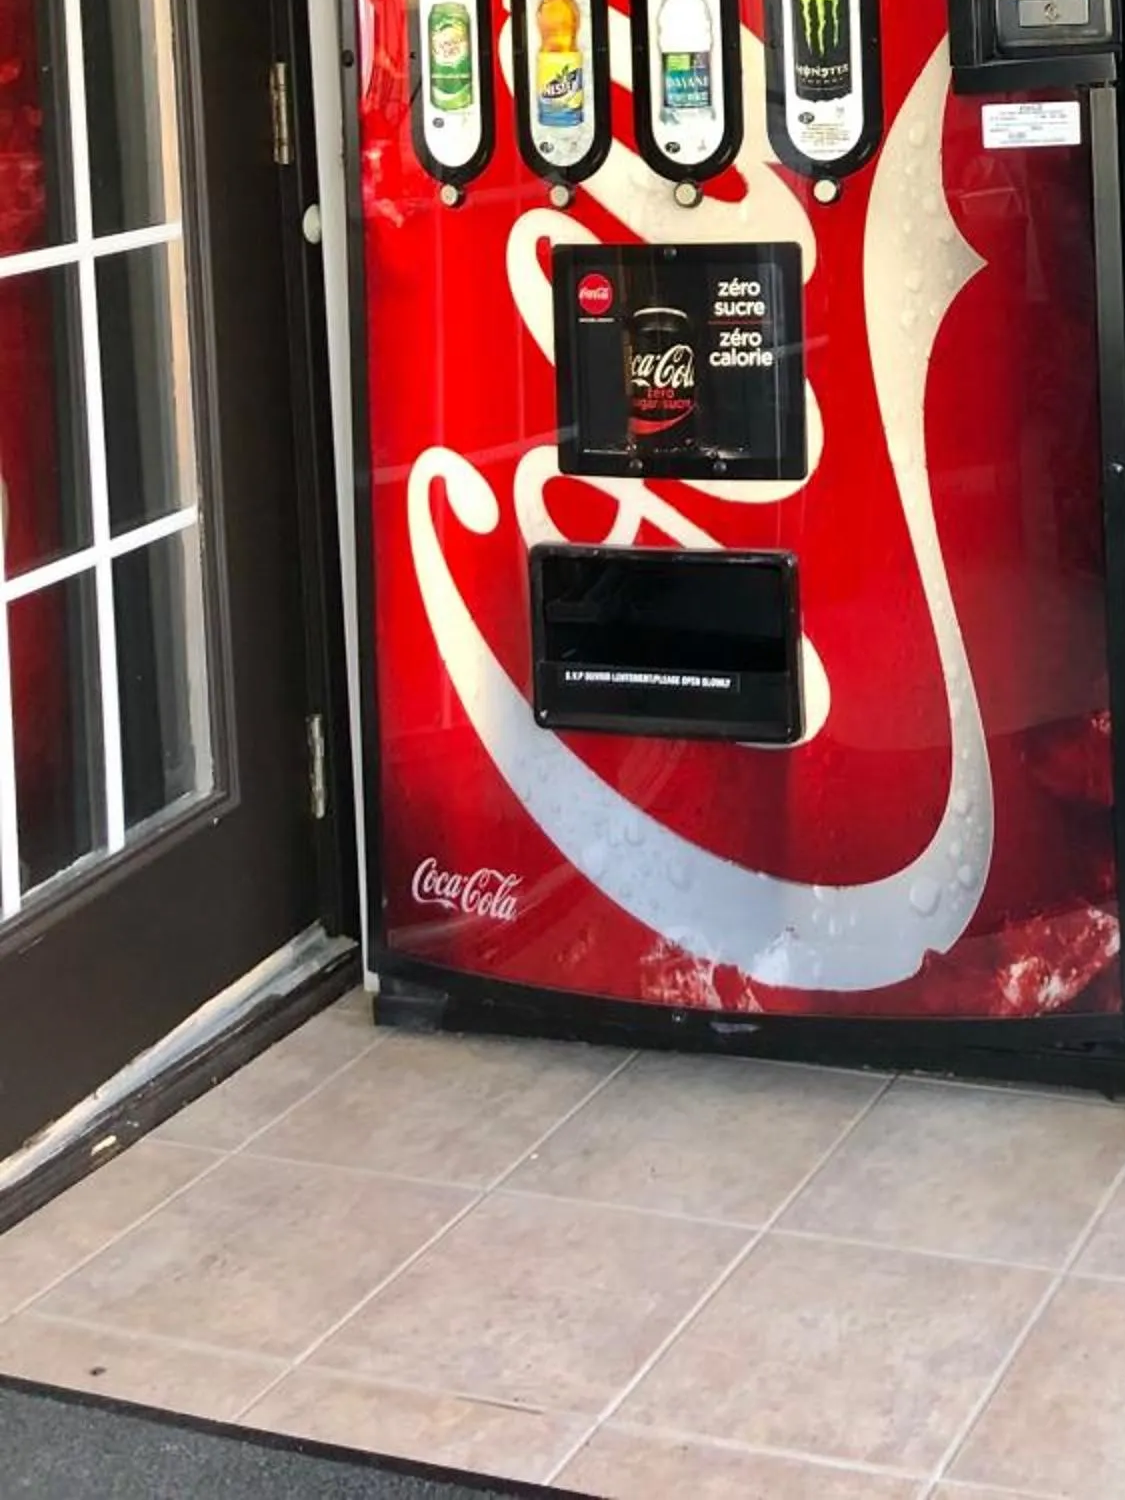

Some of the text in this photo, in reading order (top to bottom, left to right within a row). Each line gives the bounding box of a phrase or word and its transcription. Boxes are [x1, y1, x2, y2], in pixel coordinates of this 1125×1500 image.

[718, 277, 761, 297] zéro
[713, 301, 766, 316] sucre
[719, 327, 763, 347] zéro
[709, 347, 774, 367] calorie
[411, 857, 524, 921] Coca-Cola
